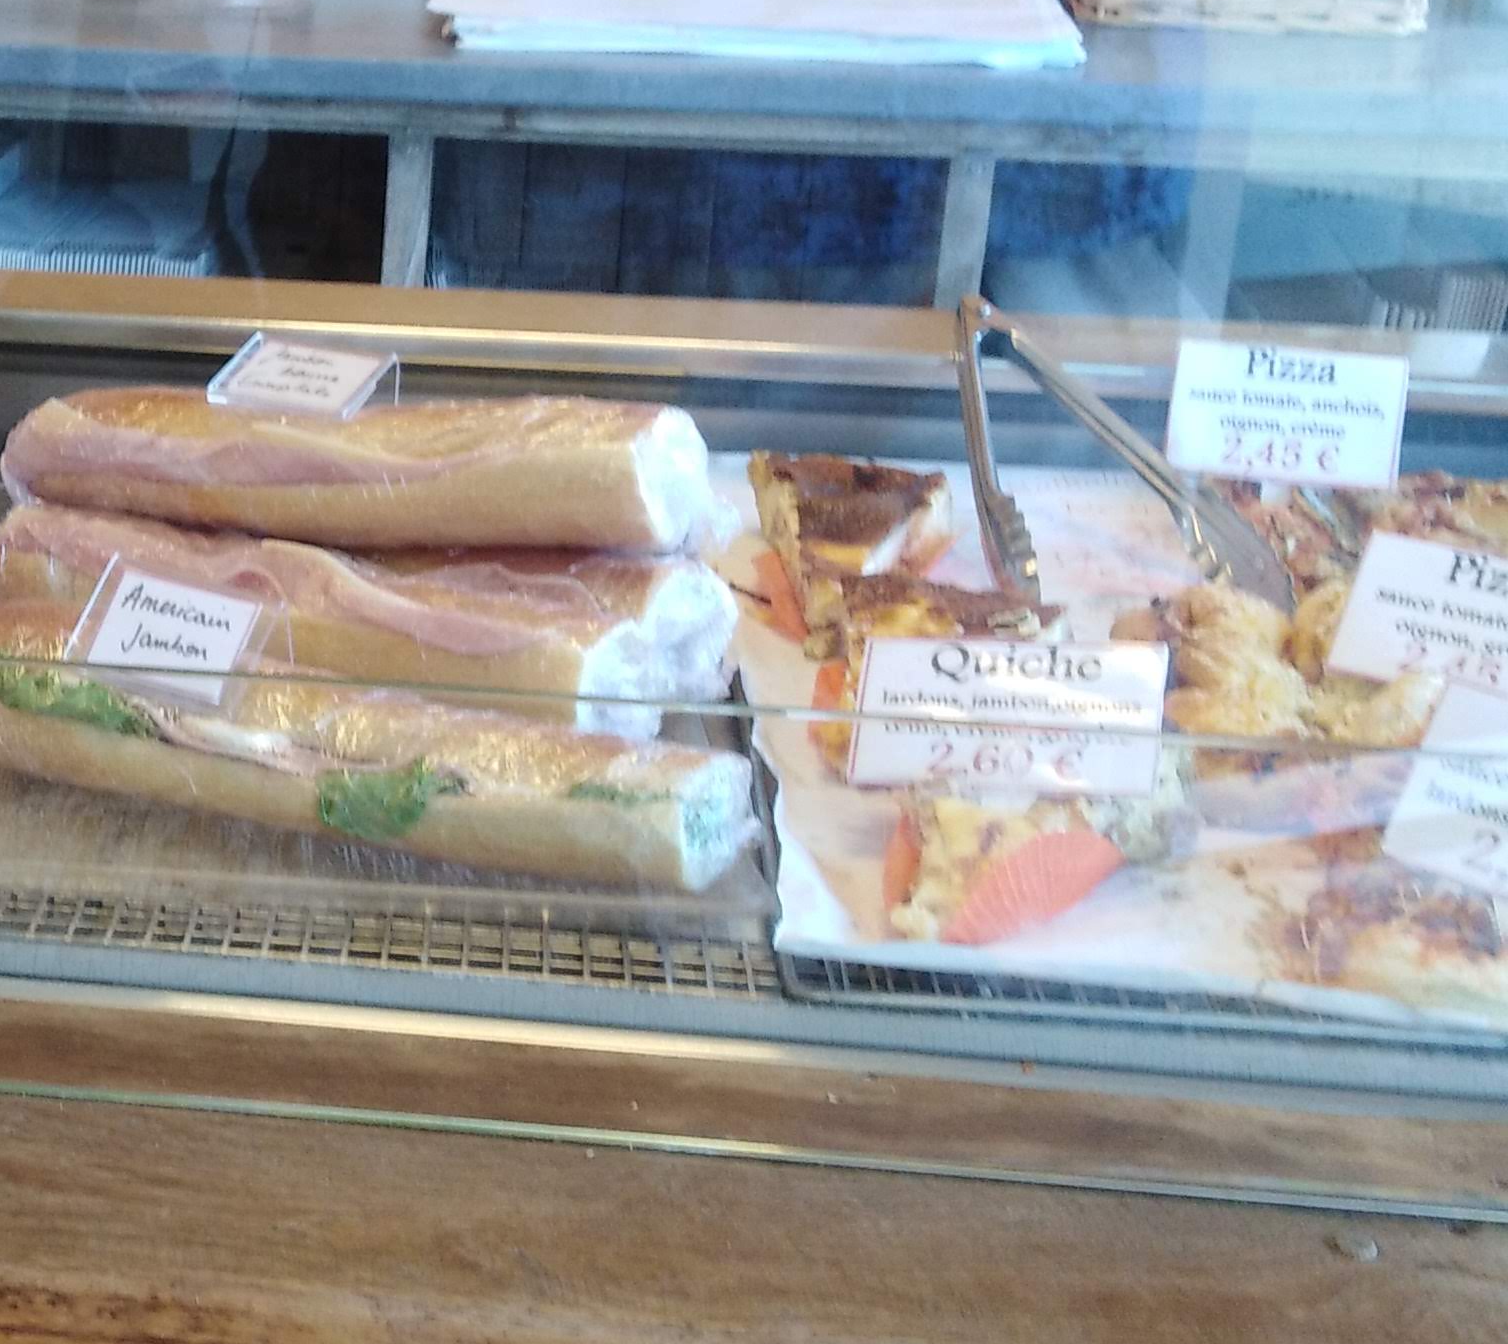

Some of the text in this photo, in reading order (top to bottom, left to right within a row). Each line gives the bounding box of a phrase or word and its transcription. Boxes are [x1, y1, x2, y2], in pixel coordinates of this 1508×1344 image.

[1247, 345, 1337, 384] Pizza
[1189, 387, 1237, 402] sauce
[930, 642, 1102, 683] Quiche
